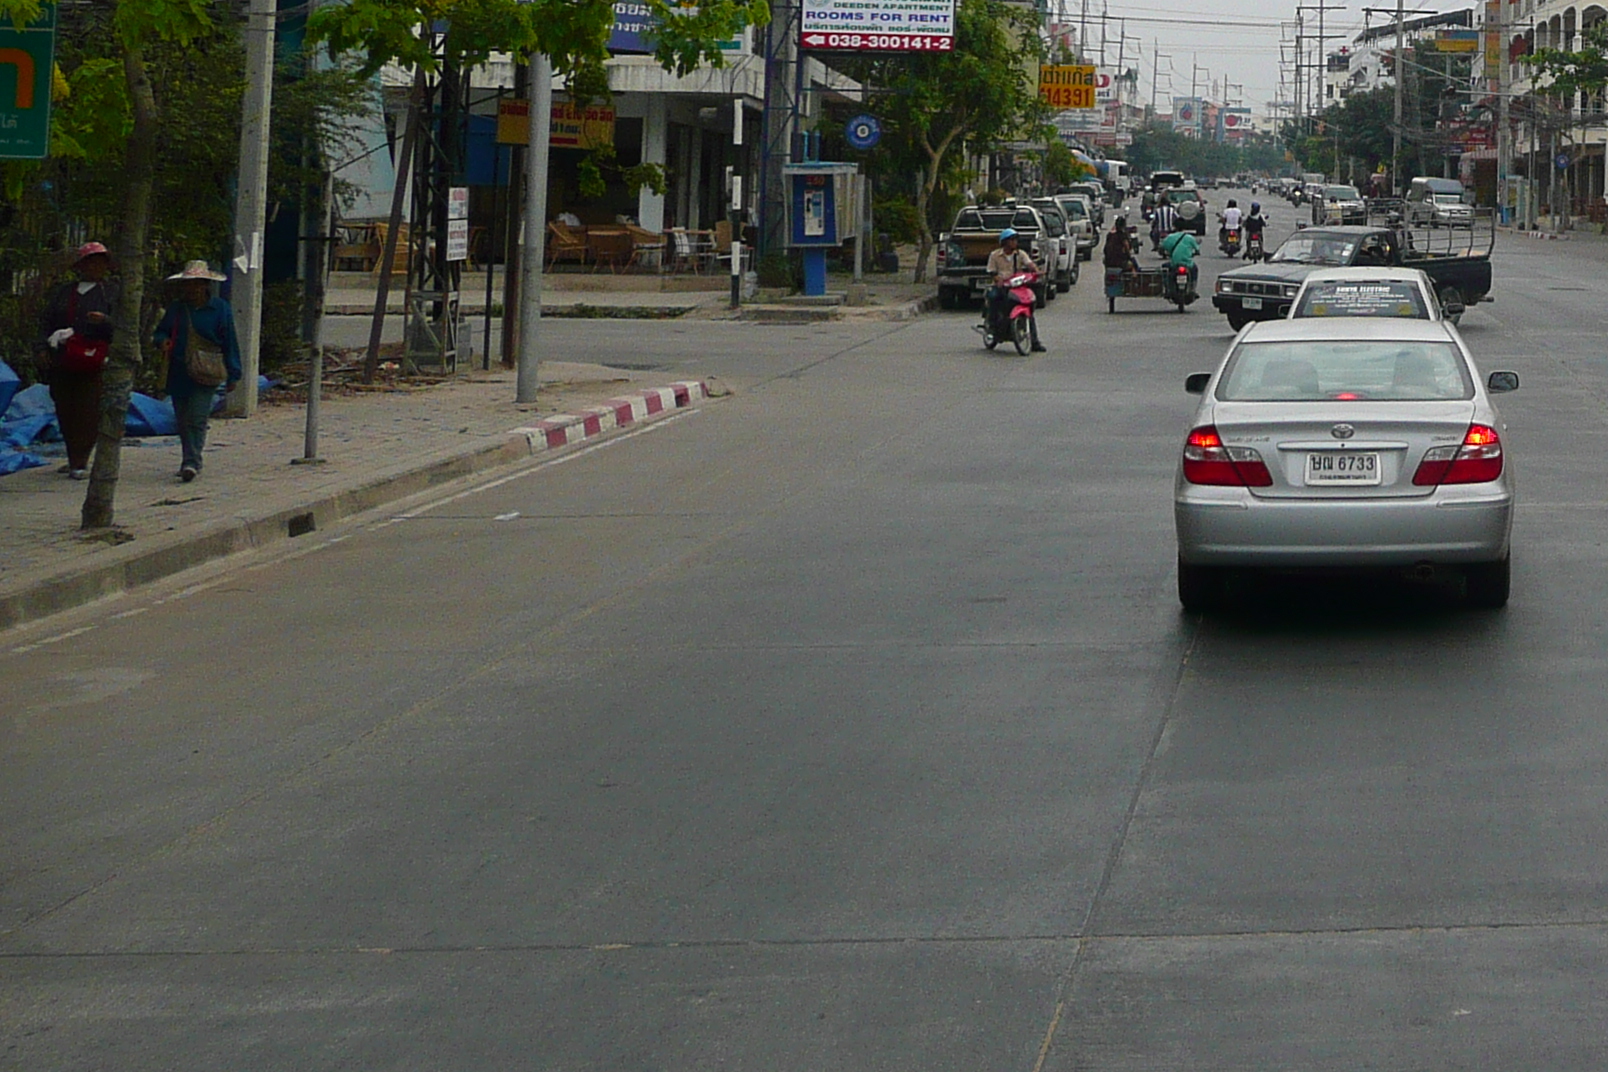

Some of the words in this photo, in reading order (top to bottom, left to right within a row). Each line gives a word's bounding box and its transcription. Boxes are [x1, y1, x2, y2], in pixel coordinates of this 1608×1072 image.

[834, 2, 879, 10] DEEDEN
[883, 3, 950, 11] APARTMENT
[806, 11, 864, 21] ROOMS
[871, 12, 902, 22] FOR
[909, 14, 950, 22] RENT
[828, 34, 951, 50] 038-300141-2
[1338, 456, 1374, 471] 6733
